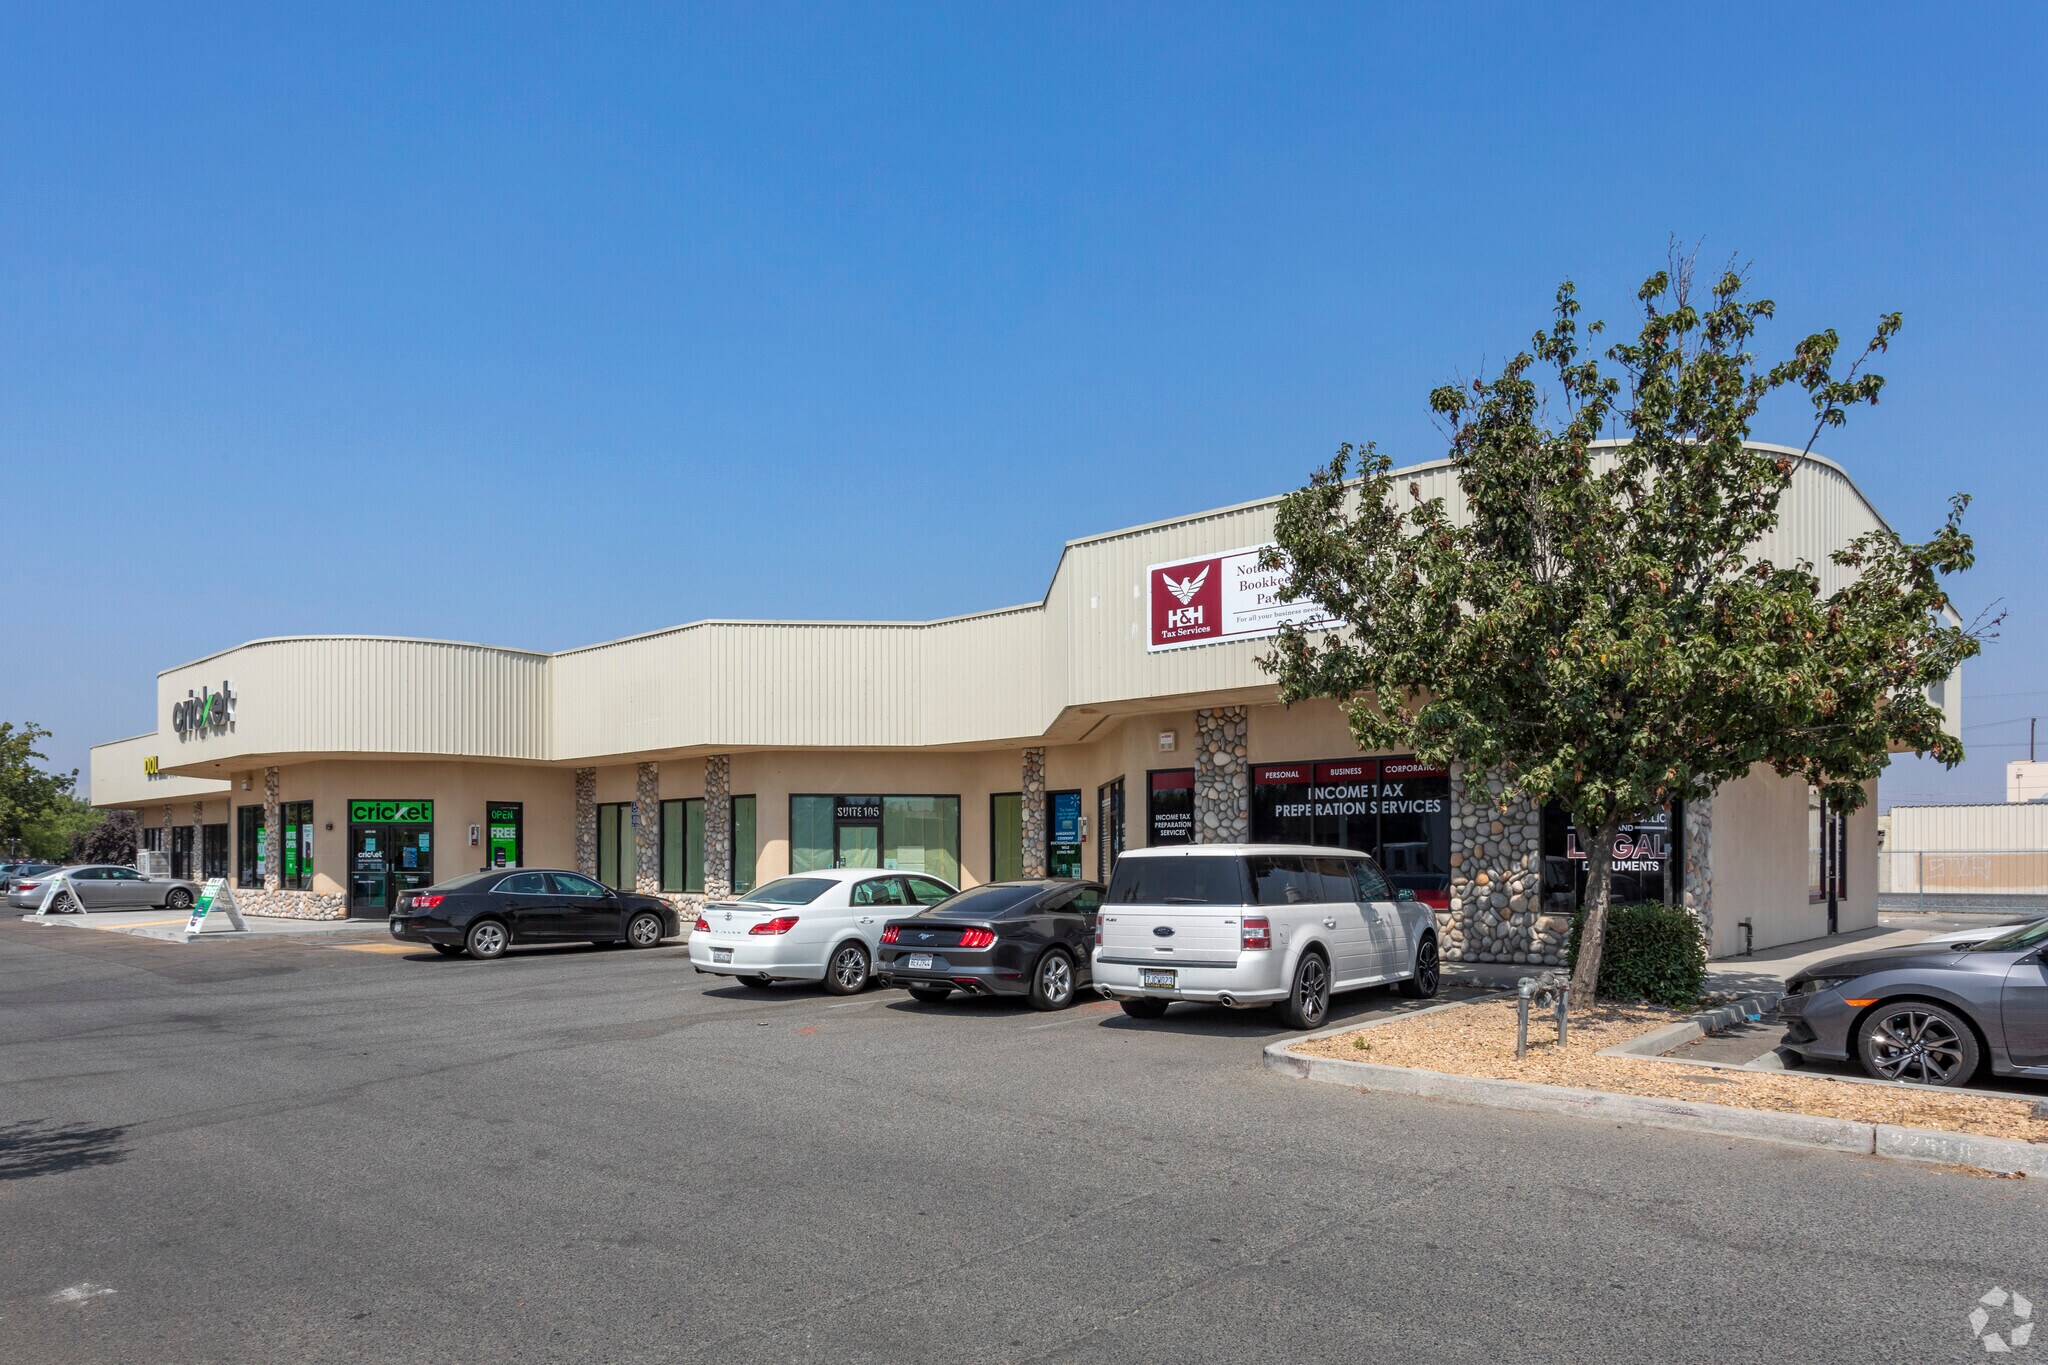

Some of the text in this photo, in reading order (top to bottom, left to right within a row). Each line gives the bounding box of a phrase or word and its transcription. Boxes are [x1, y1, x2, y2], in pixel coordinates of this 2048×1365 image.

[1168, 605, 1203, 629] H&H
[1258, 612, 1273, 622] your
[1274, 609, 1302, 618] business
[1161, 626, 1211, 639] Tax Services
[172, 680, 234, 733] cricket
[1265, 763, 1438, 779] PERSONAL BUSINESS CORPORATIO
[1308, 784, 1404, 800] INCOME TAX
[353, 802, 429, 820] cricket
[491, 811, 513, 819] OPEN
[837, 806, 880, 817] SUITE 105
[1275, 799, 1441, 817] PREPERATION SERVICES
[490, 828, 516, 838] FREE
[1567, 834, 1667, 859] LGAL
[1582, 861, 1659, 871] DUMENTS
